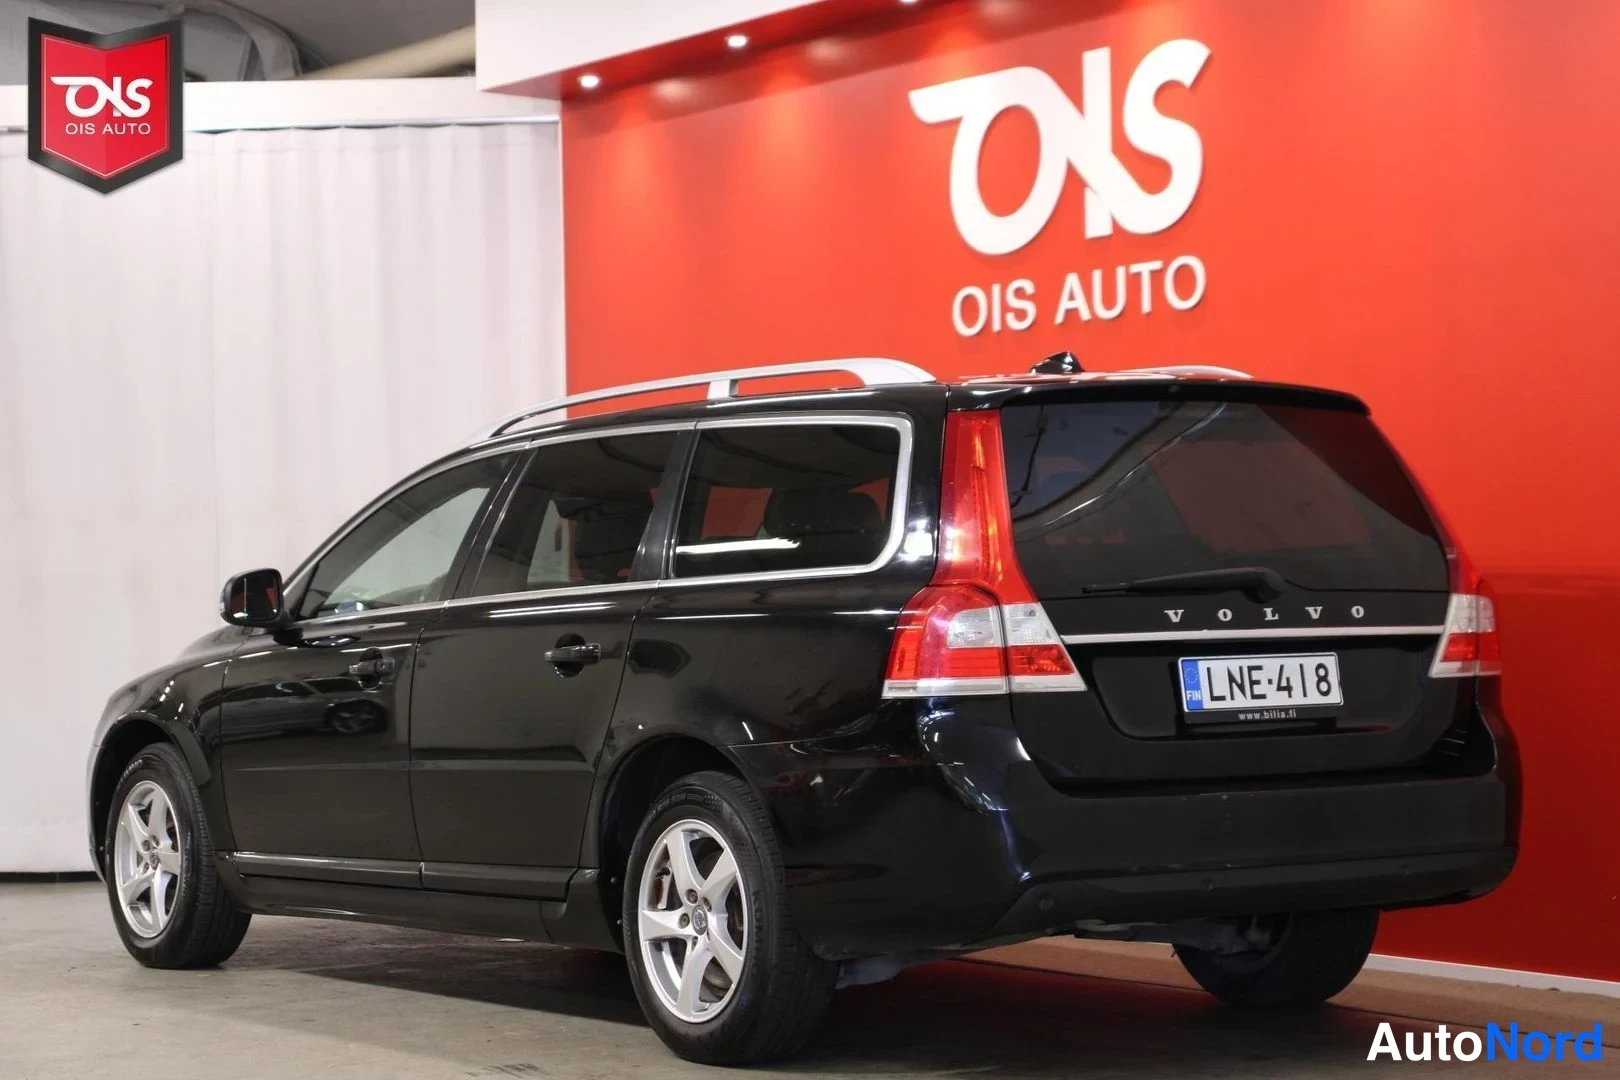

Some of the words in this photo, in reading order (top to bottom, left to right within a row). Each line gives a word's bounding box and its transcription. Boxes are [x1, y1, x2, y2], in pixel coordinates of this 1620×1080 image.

[952, 278, 1037, 337] OIS
[1054, 255, 1207, 326] AUTO
[1164, 605, 1366, 624] VOLVO
[1186, 690, 1202, 702] FIN
[1238, 708, 1297, 721] www.bilia.fi
